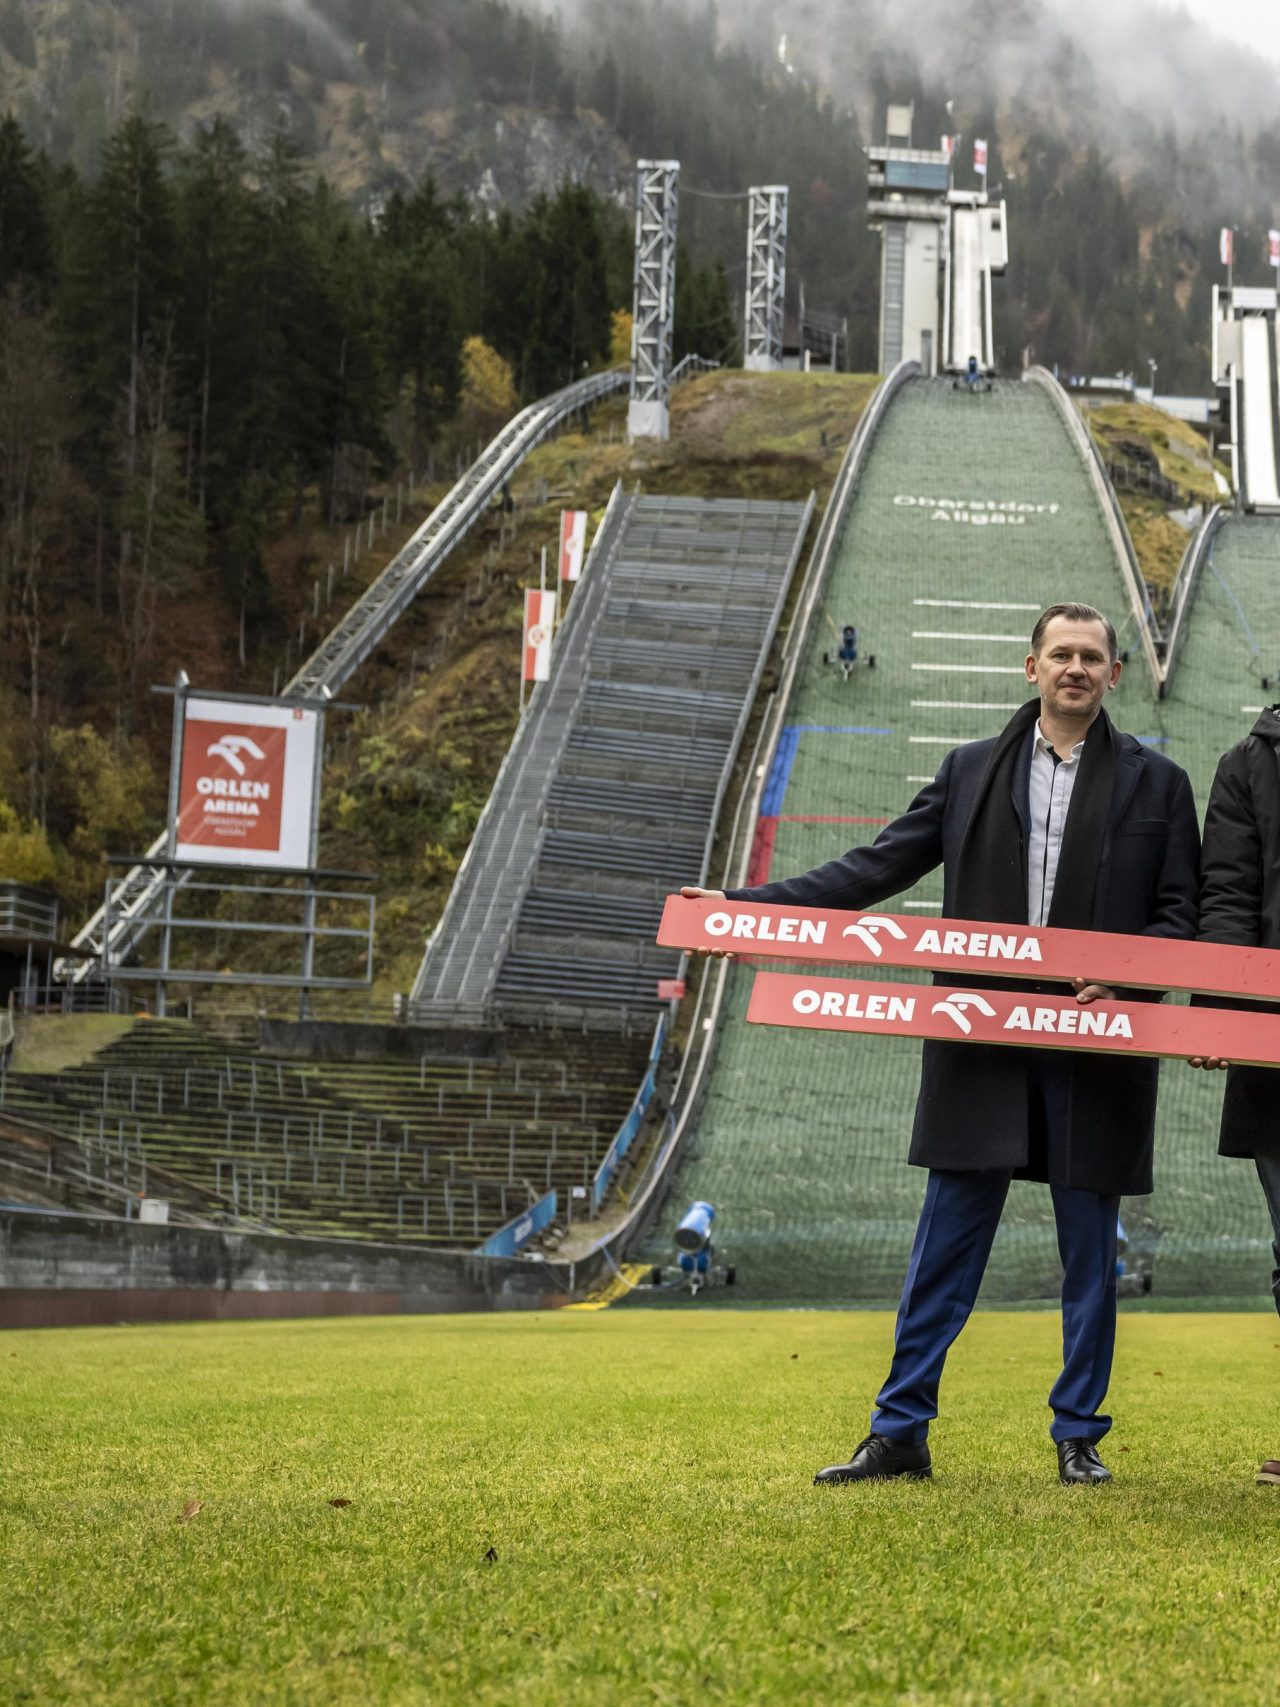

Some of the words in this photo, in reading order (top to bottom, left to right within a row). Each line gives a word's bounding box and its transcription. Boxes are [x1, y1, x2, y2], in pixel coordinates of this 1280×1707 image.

[893, 494, 1060, 514] Oberstdorf
[196, 776, 270, 800] ORLEN
[203, 798, 260, 817] ARENA
[704, 911, 828, 945] ORLEN
[914, 929, 1044, 962] ARENA
[792, 988, 916, 1022] ORLEN
[1003, 1006, 1134, 1039] ARENA
